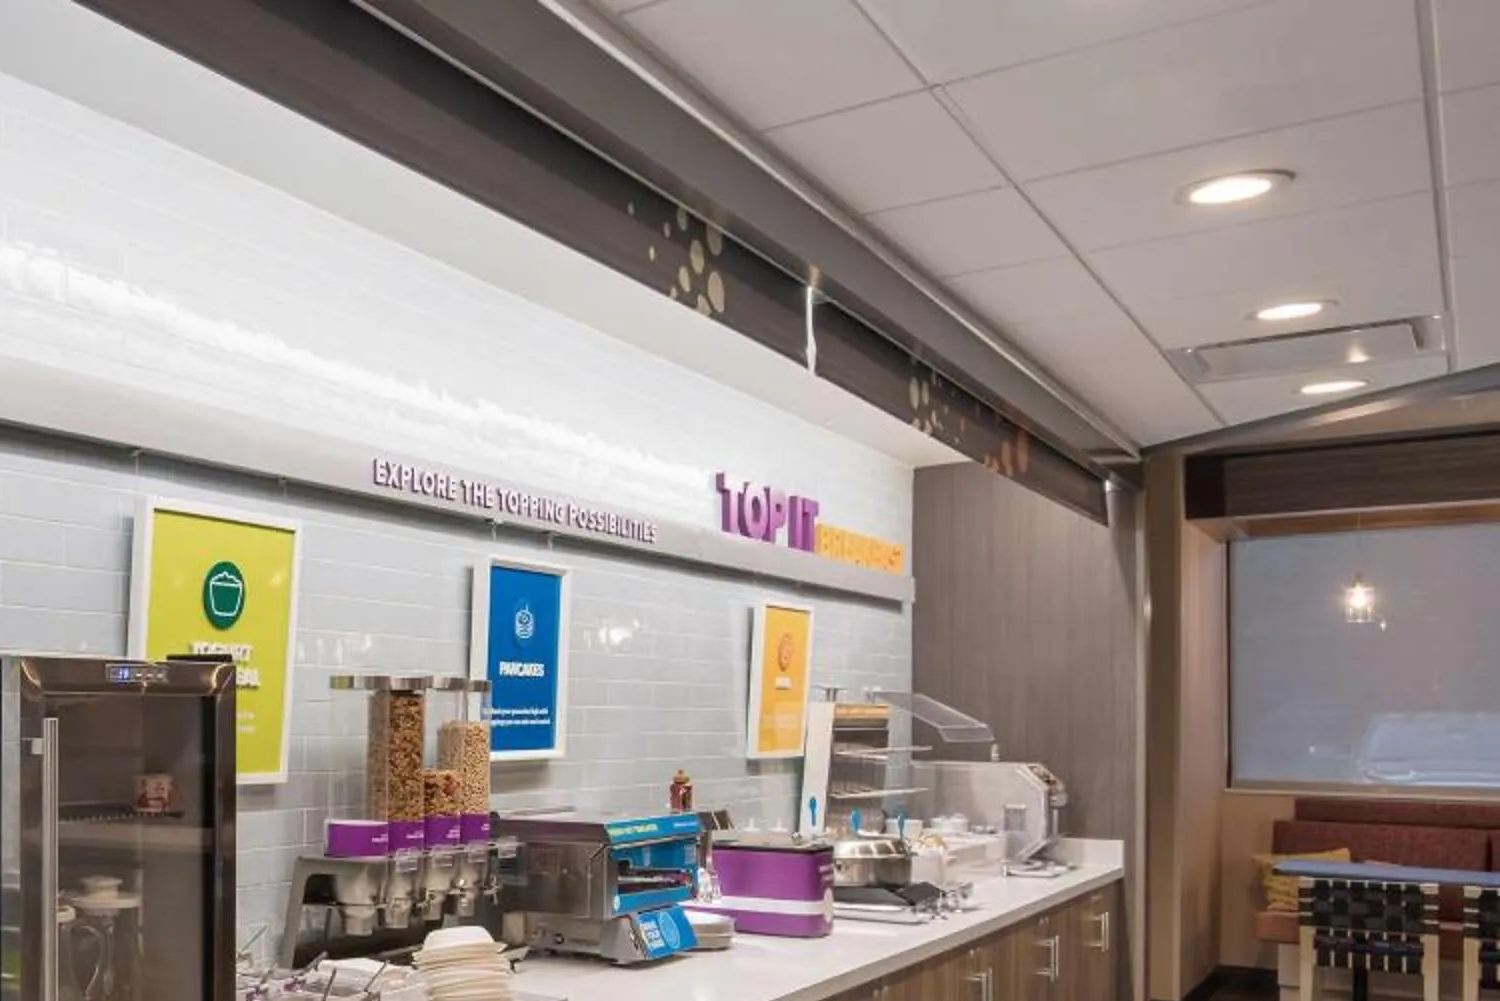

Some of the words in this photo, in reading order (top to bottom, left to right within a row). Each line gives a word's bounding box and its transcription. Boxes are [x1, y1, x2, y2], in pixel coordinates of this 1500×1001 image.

[373, 458, 457, 500] EXPLORE
[460, 479, 494, 509] THE
[497, 488, 565, 524] TOPPING
[567, 503, 658, 544] POSSIBILITIES
[715, 472, 786, 545] TOP
[788, 495, 819, 553] IT
[499, 661, 545, 677] PANCAKES
